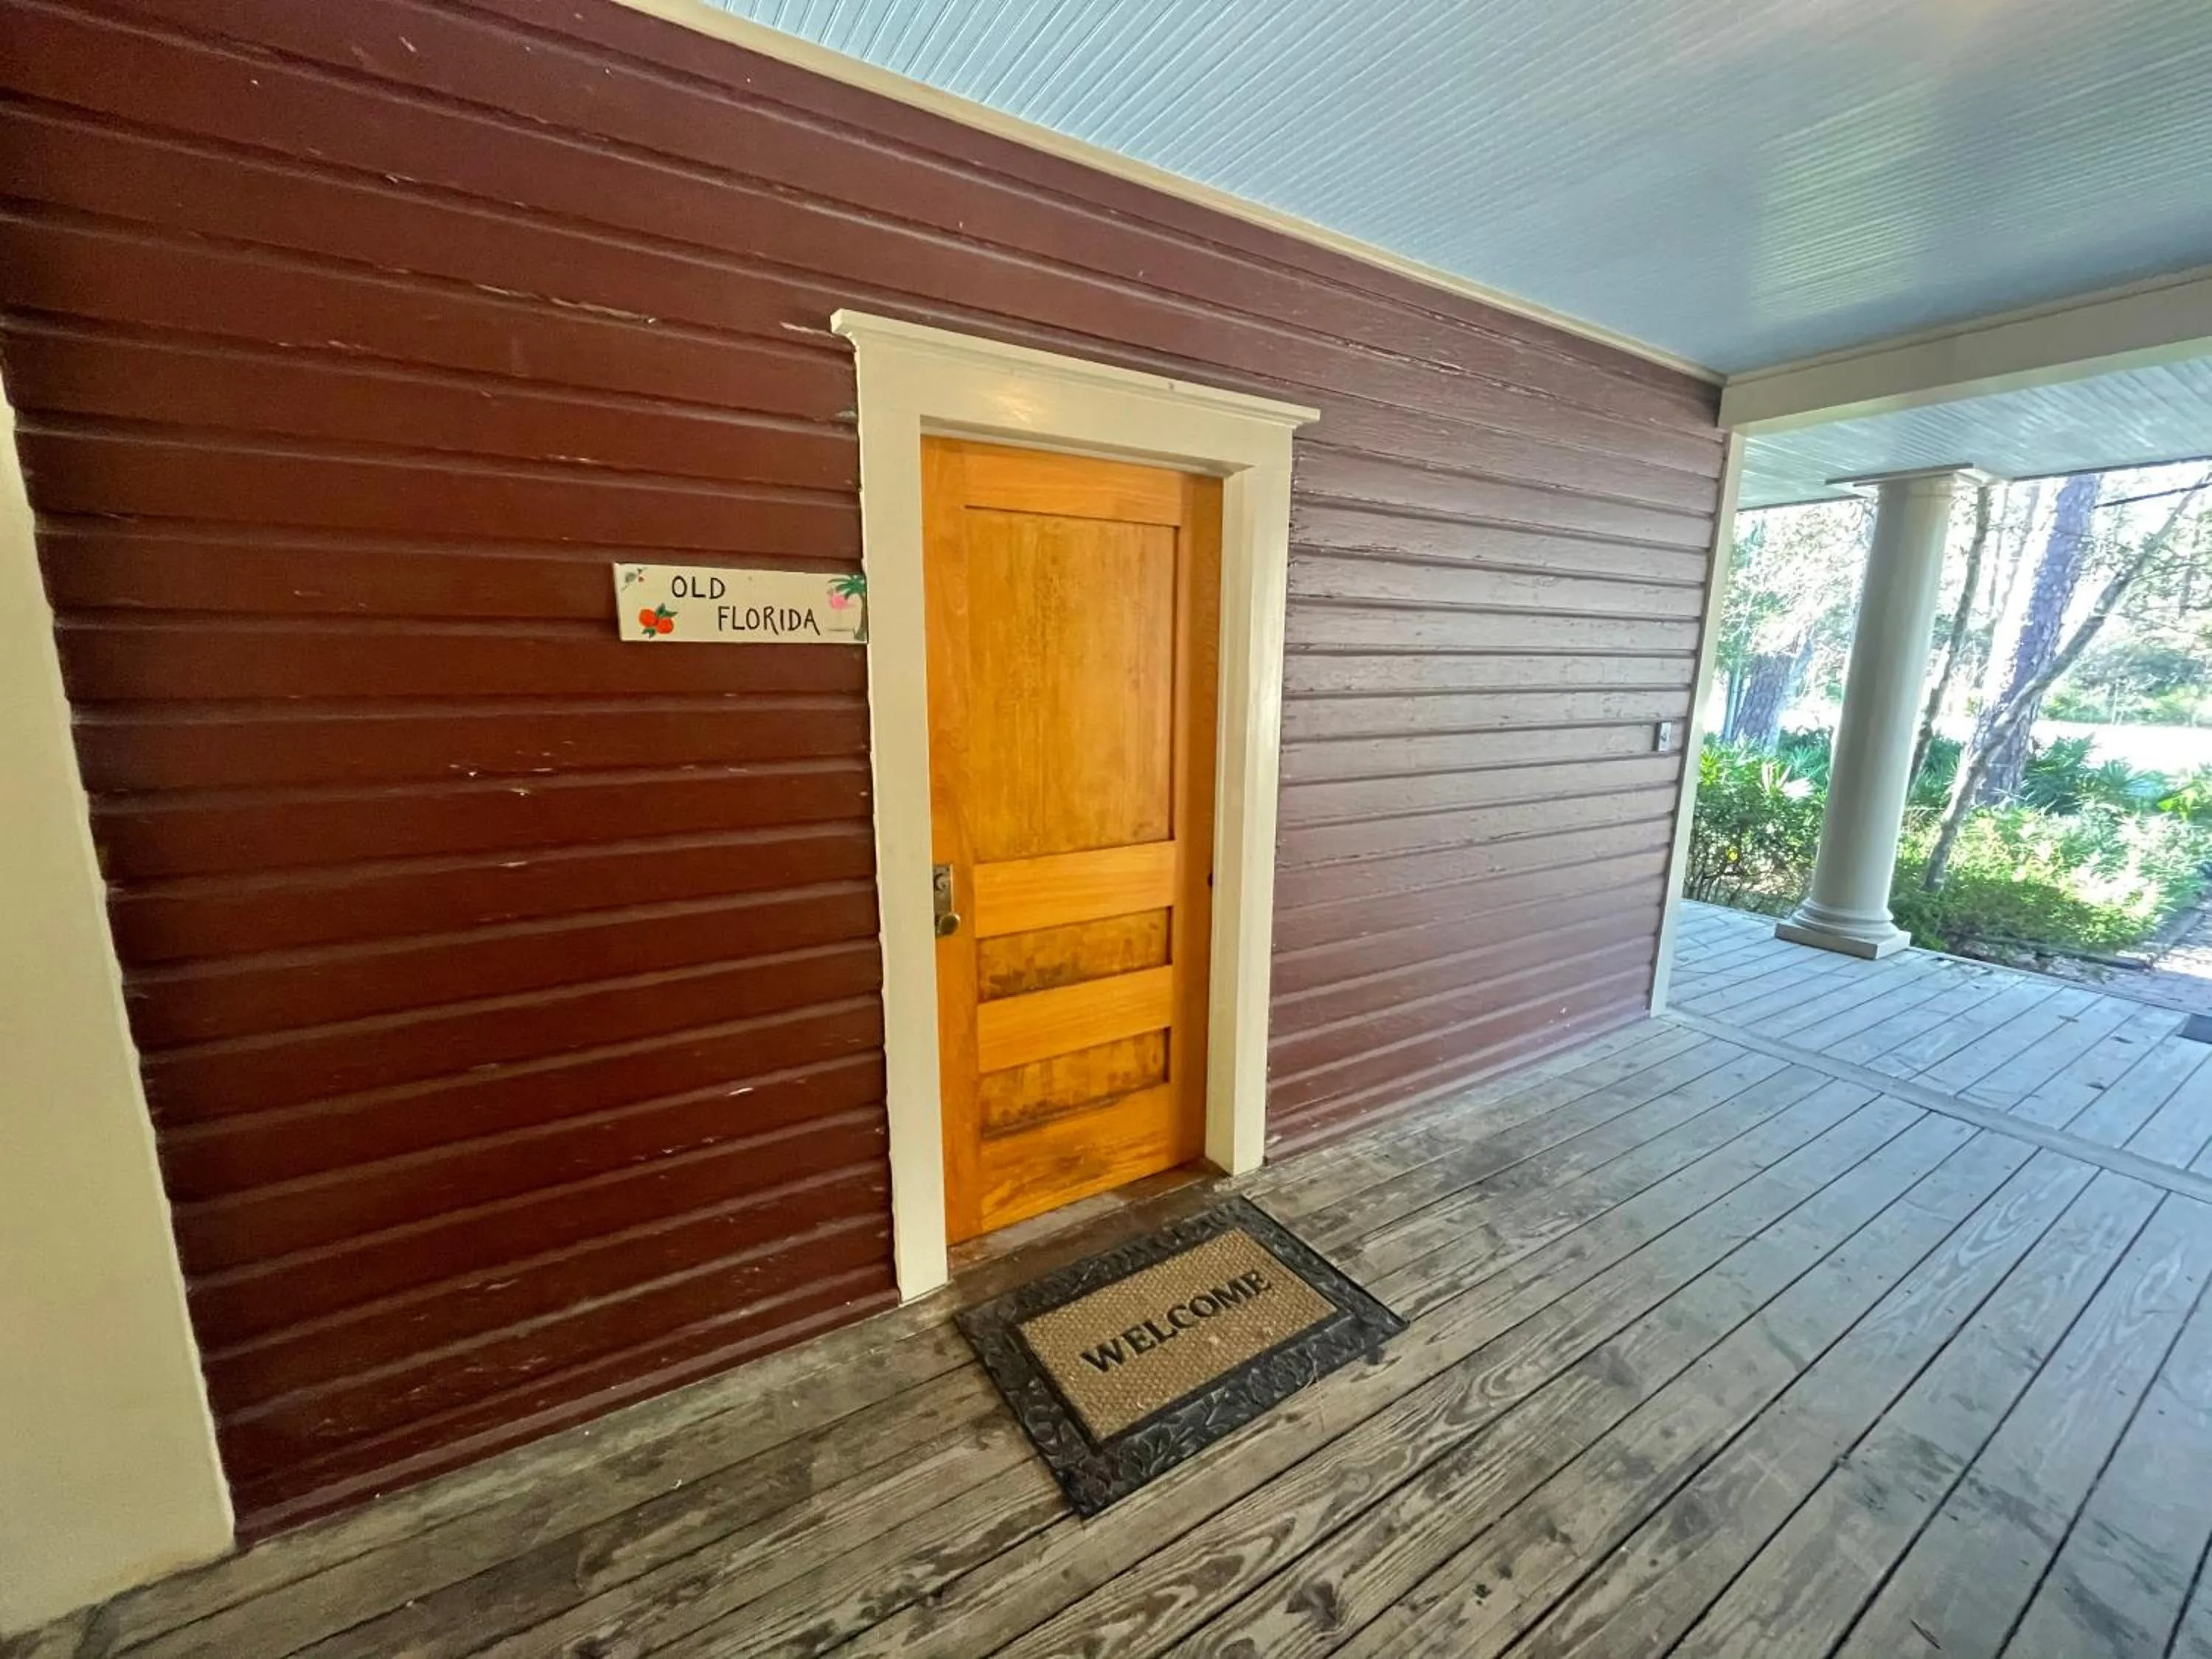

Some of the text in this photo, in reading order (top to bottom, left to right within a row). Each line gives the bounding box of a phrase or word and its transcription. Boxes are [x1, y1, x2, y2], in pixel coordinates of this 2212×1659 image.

[672, 575, 726, 599] OLD
[717, 605, 821, 636] FLORIDA
[1080, 1269, 1272, 1373] WELCOME
